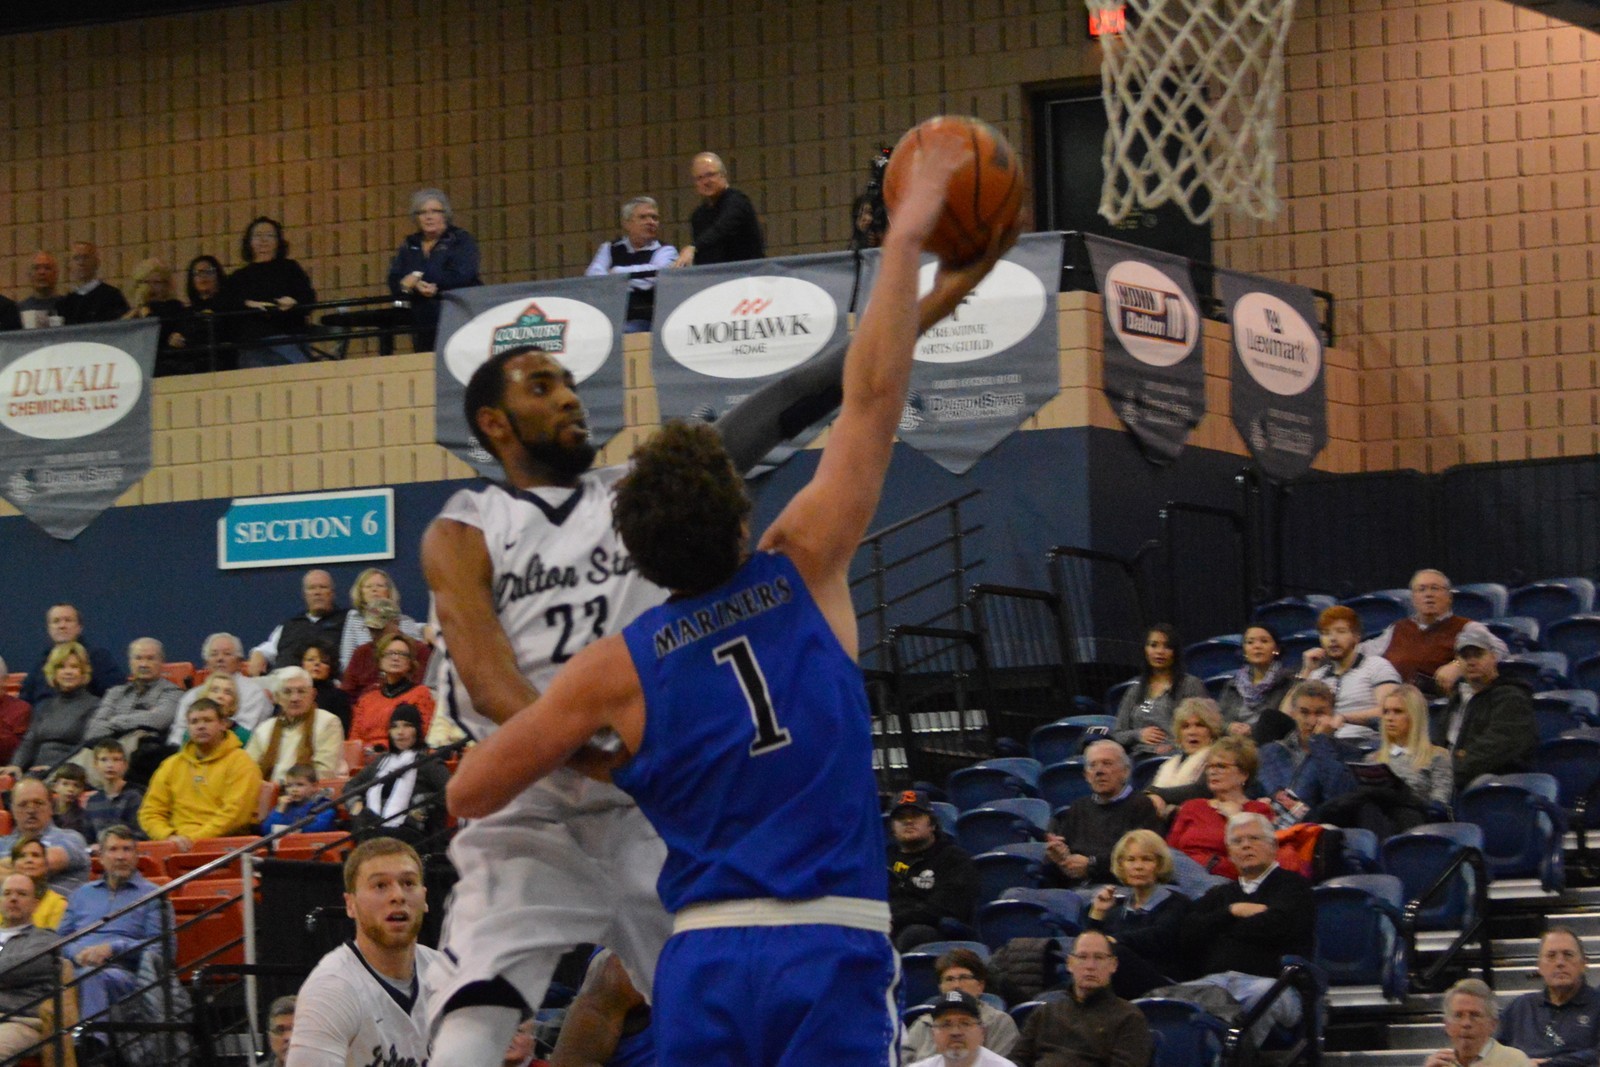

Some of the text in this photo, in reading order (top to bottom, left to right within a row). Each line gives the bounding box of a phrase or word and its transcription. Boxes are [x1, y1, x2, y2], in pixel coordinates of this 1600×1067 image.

[686, 315, 811, 345] MOHAWK
[733, 343, 767, 354] HOME
[12, 363, 119, 397] DUVALL
[93, 394, 118, 410] LLC
[234, 510, 379, 543] SECTION 6
[653, 576, 793, 659] MARINERS
[712, 636, 792, 756] 1
